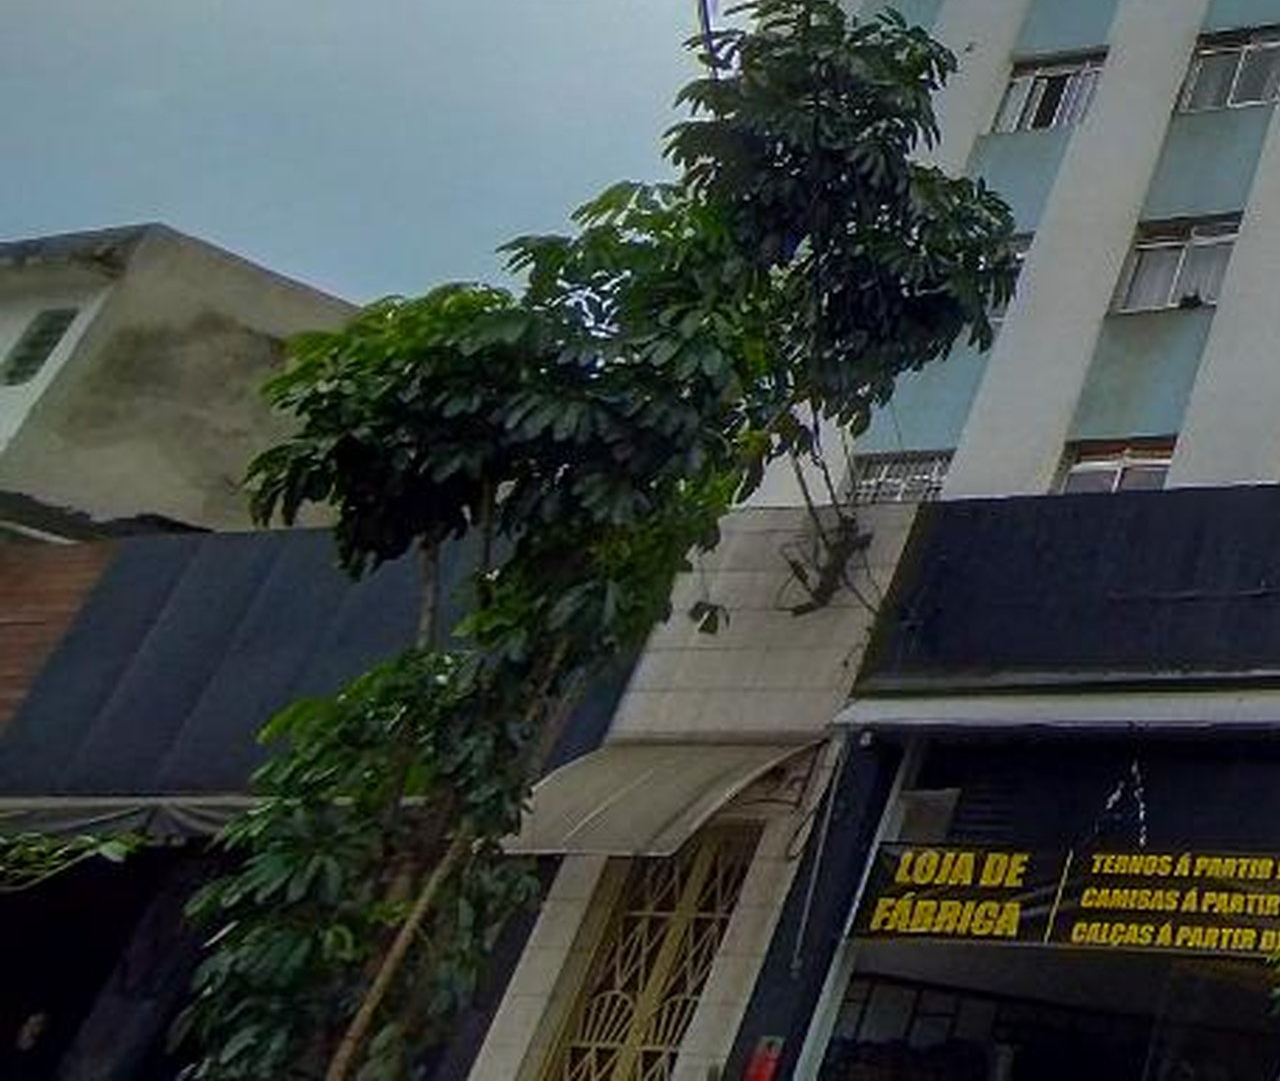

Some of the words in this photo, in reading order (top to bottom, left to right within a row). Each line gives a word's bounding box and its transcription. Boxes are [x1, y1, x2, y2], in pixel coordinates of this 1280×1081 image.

[895, 849, 975, 886] LOJA
[980, 852, 1030, 887] DE
[1092, 854, 1172, 877] TERNOS
[1193, 856, 1275, 880] PARTIR
[1080, 885, 1180, 912] CAMISAS
[869, 891, 1022, 937] FÁBRICA
[1071, 921, 1156, 947] CALÇAS
[1175, 925, 1257, 950] PARTIR
